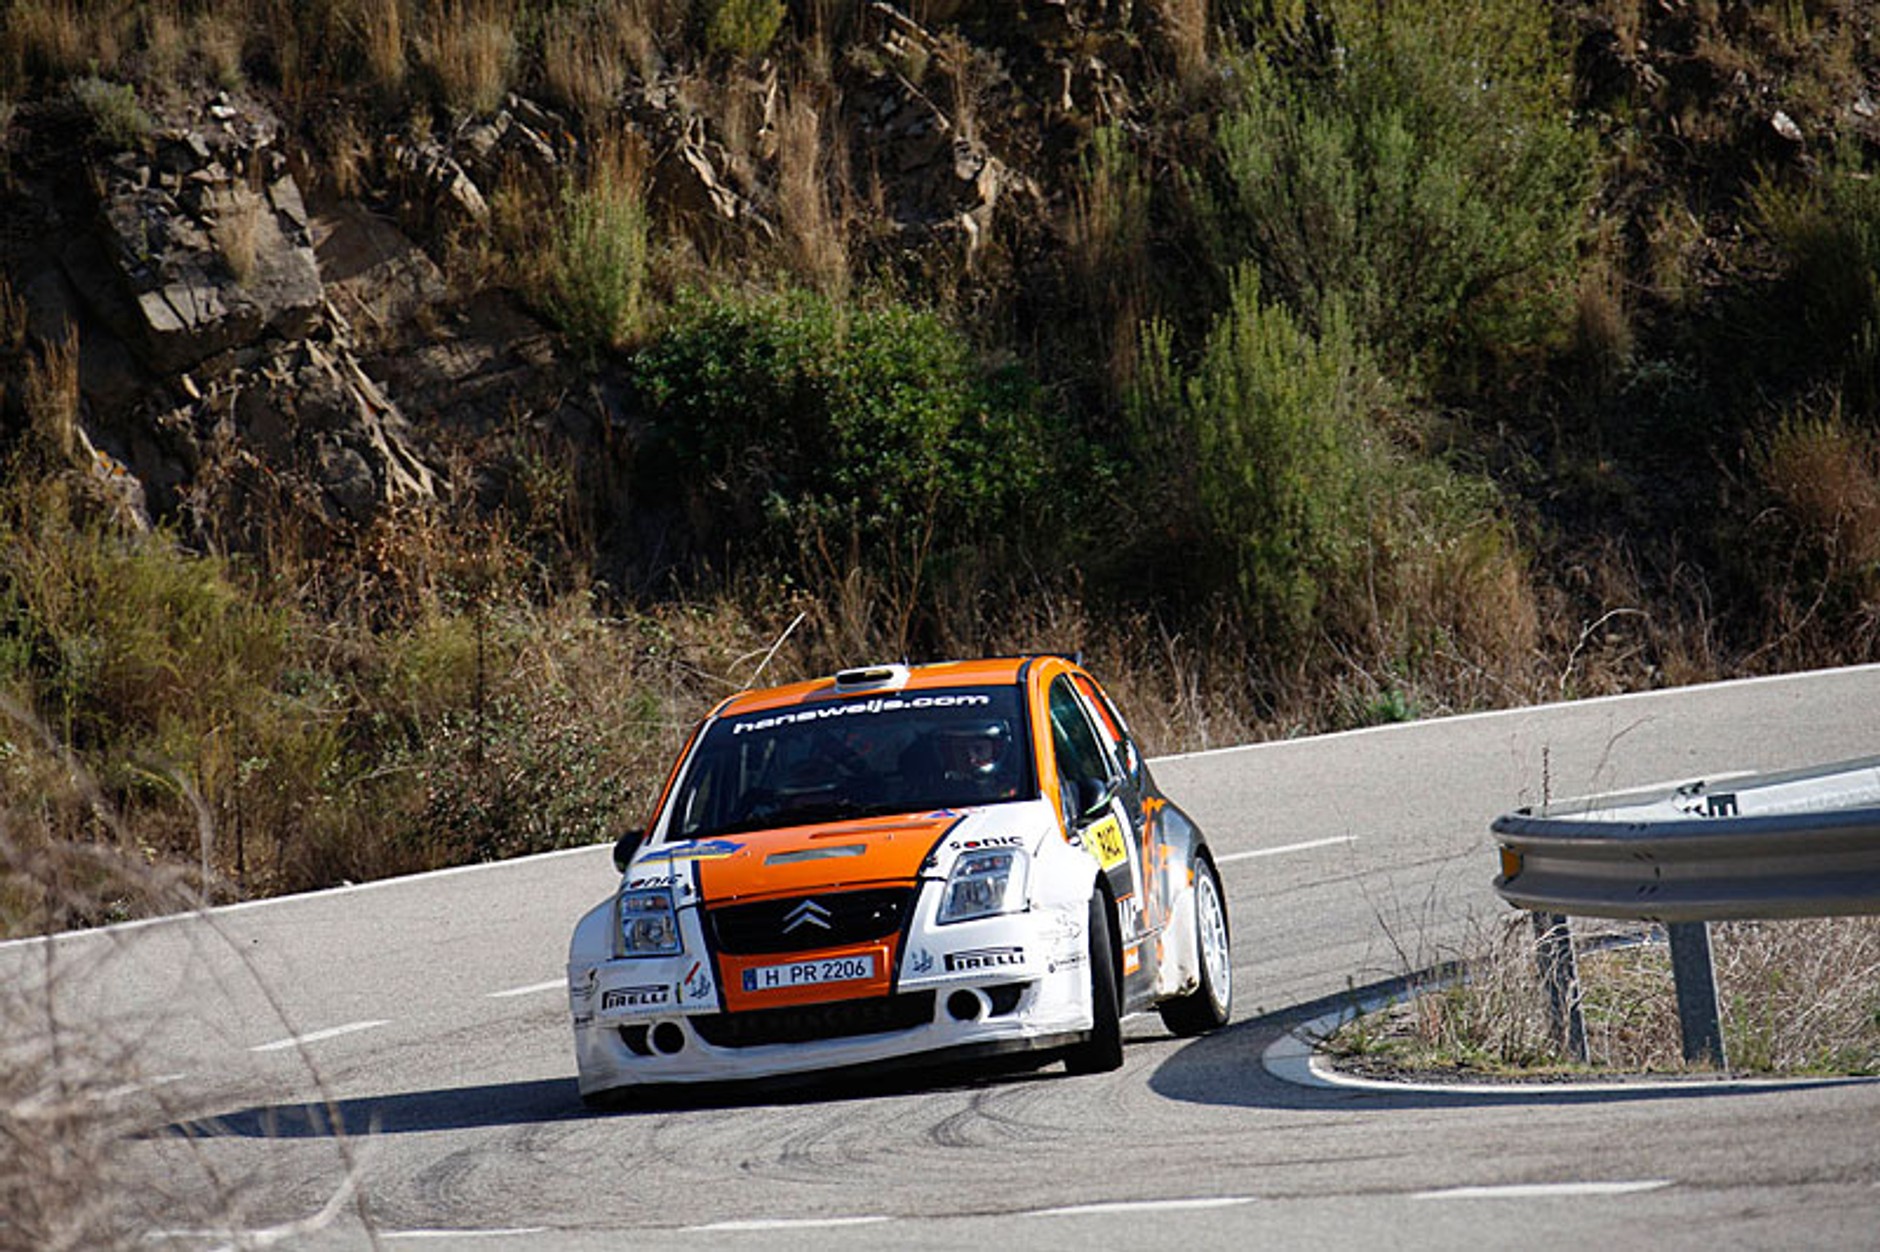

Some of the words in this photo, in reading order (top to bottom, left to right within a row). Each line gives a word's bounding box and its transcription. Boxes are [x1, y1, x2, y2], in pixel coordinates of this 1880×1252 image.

[732, 694, 989, 734] hansweijs.com
[943, 946, 1025, 971] PIRELLI
[765, 968, 779, 985] H
[790, 965, 817, 983] PR
[822, 960, 866, 979] 2206
[601, 984, 669, 1010] PIRELLI
